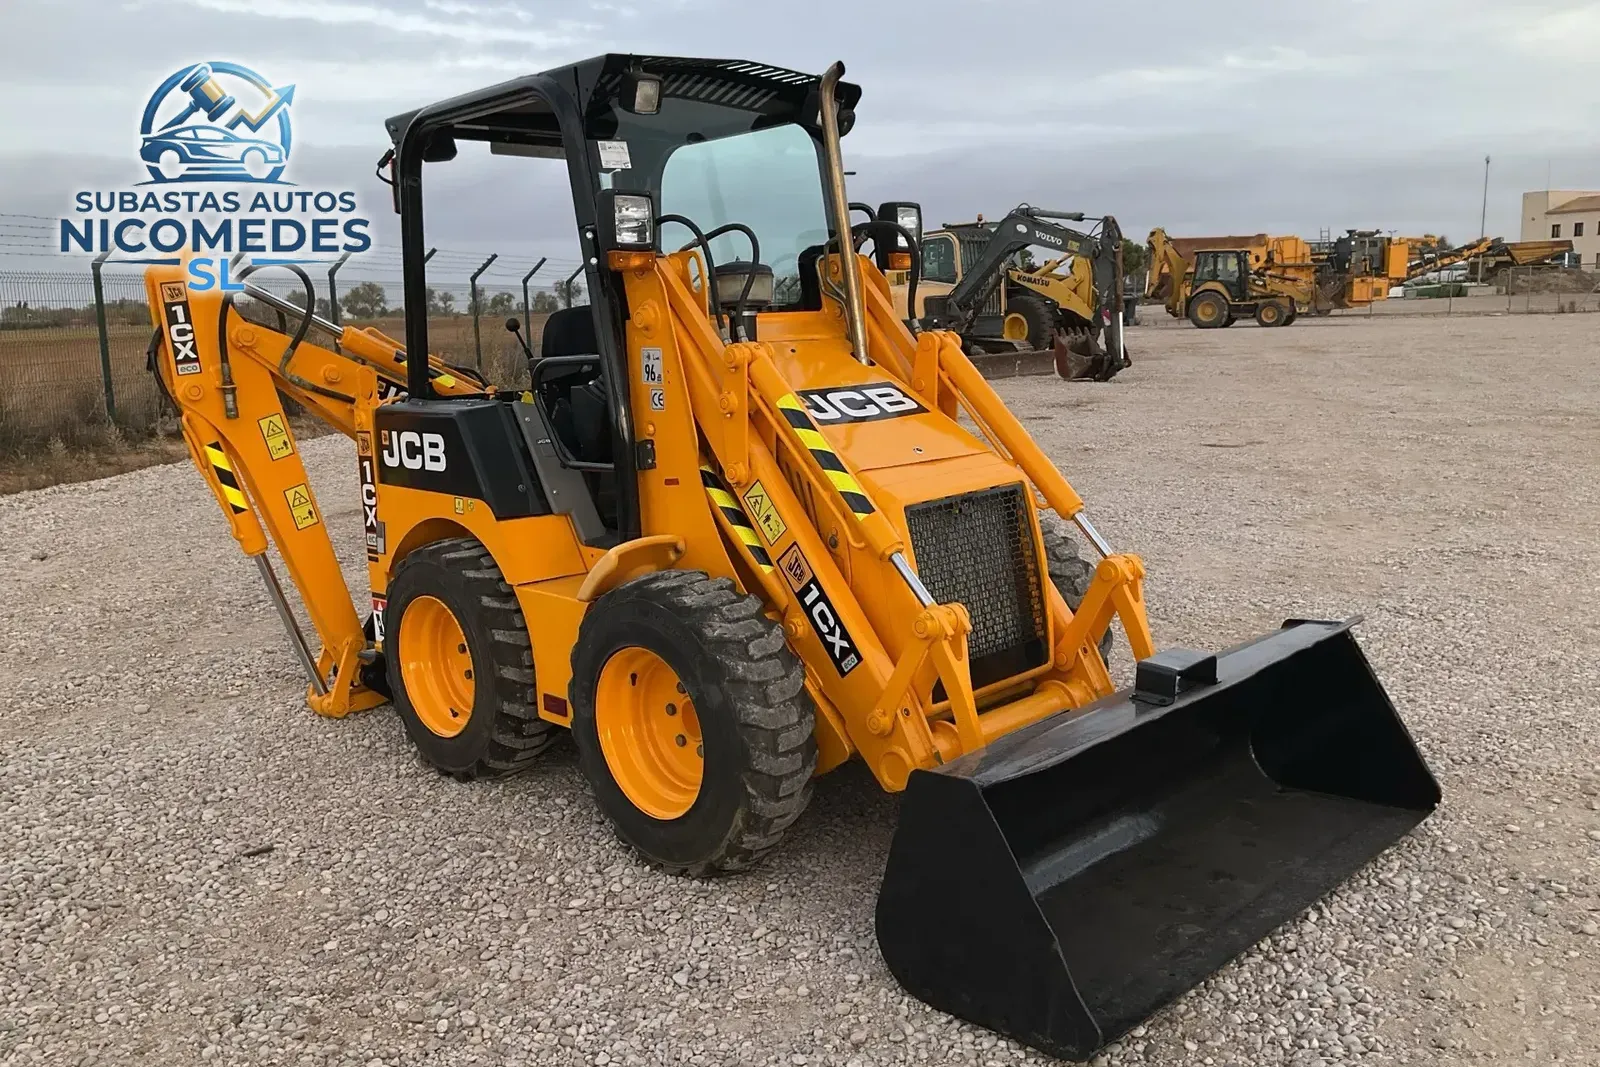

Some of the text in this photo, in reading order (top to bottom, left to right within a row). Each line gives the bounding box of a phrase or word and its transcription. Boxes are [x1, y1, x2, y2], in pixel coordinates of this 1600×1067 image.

[1035, 230, 1063, 246] VOLVO
[1016, 274, 1050, 287] KOMATSU
[170, 304, 198, 360] 1CX
[180, 364, 198, 373] eco
[644, 363, 656, 381] 96
[808, 387, 918, 420] JCB
[382, 430, 447, 472] JCB
[362, 460, 377, 528] 1CX
[787, 556, 805, 582] JCB
[803, 583, 850, 660] 1CX
[843, 656, 857, 670] eco
